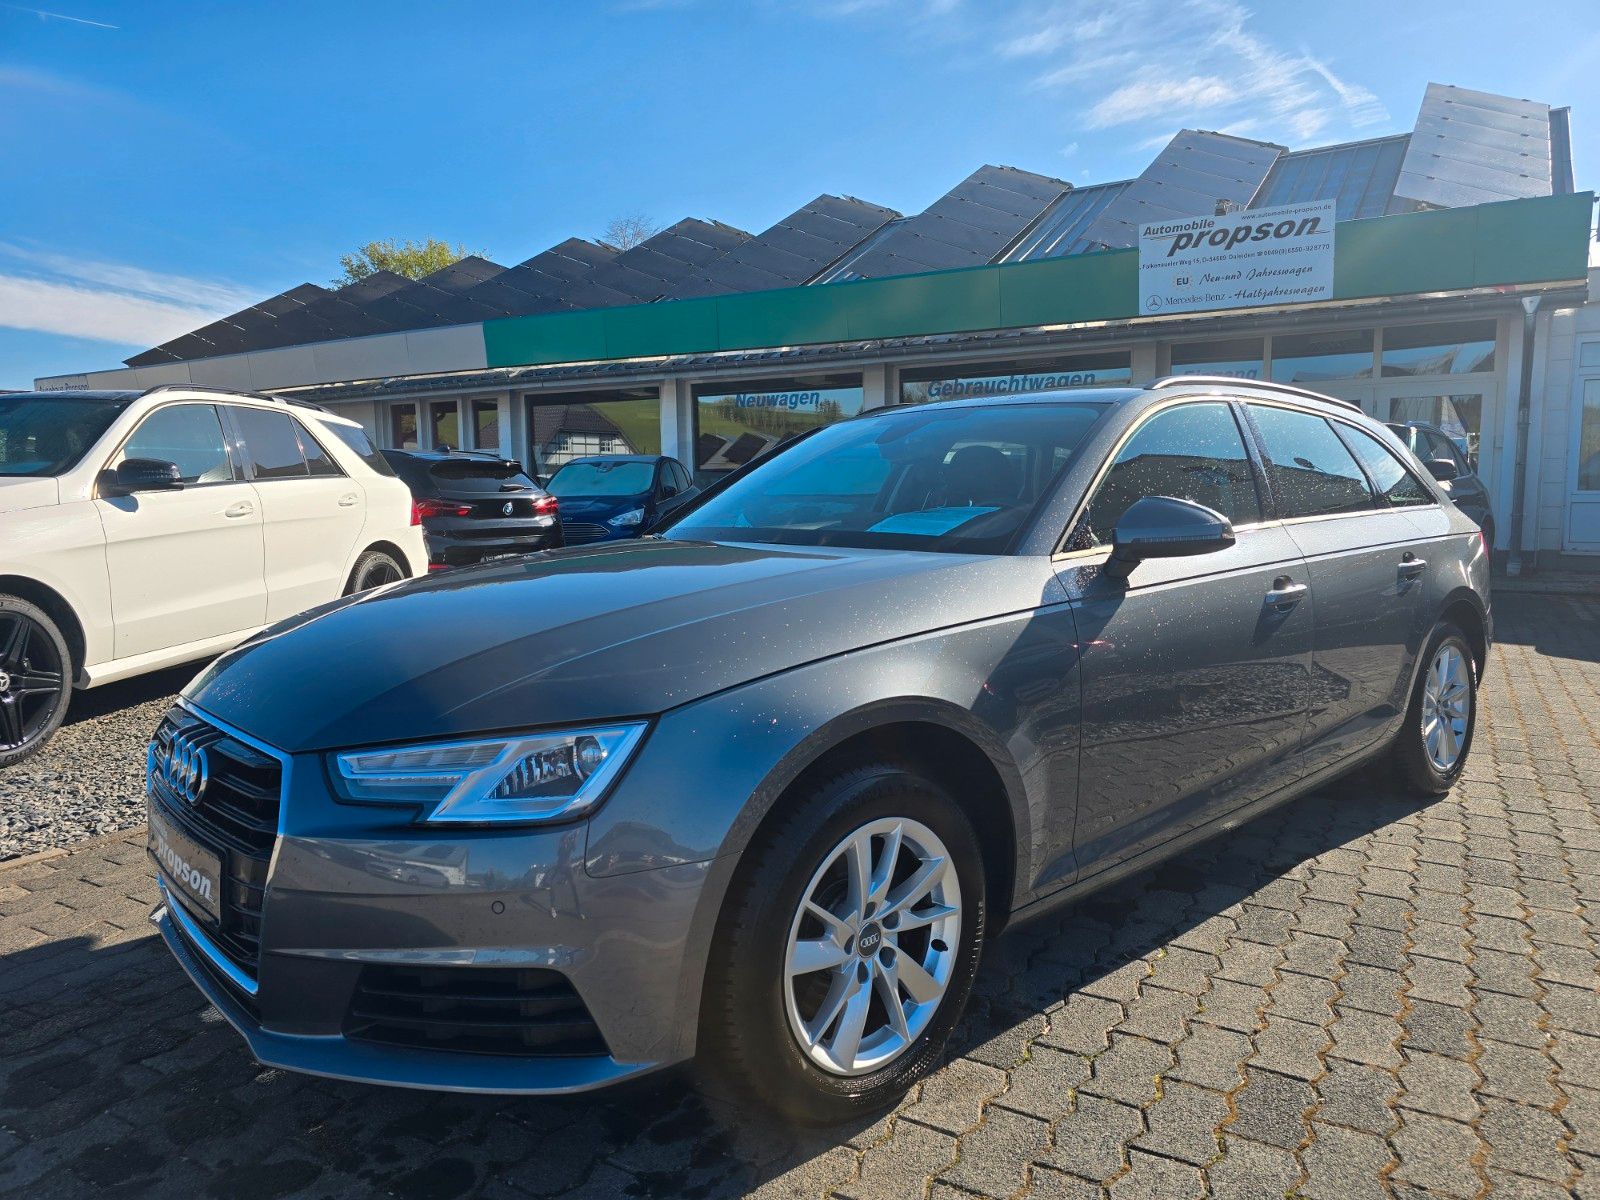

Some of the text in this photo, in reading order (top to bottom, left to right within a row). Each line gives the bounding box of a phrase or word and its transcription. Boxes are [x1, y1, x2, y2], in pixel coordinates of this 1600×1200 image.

[1143, 219, 1215, 236] Automobile
[1167, 217, 1321, 257] propson
[1176, 277, 1189, 286] EU
[1246, 266, 1313, 281] Jahreswagen
[928, 373, 1096, 398] Gebrauchtwagen
[735, 391, 820, 410] Neuwagen
[159, 838, 212, 899] propson
